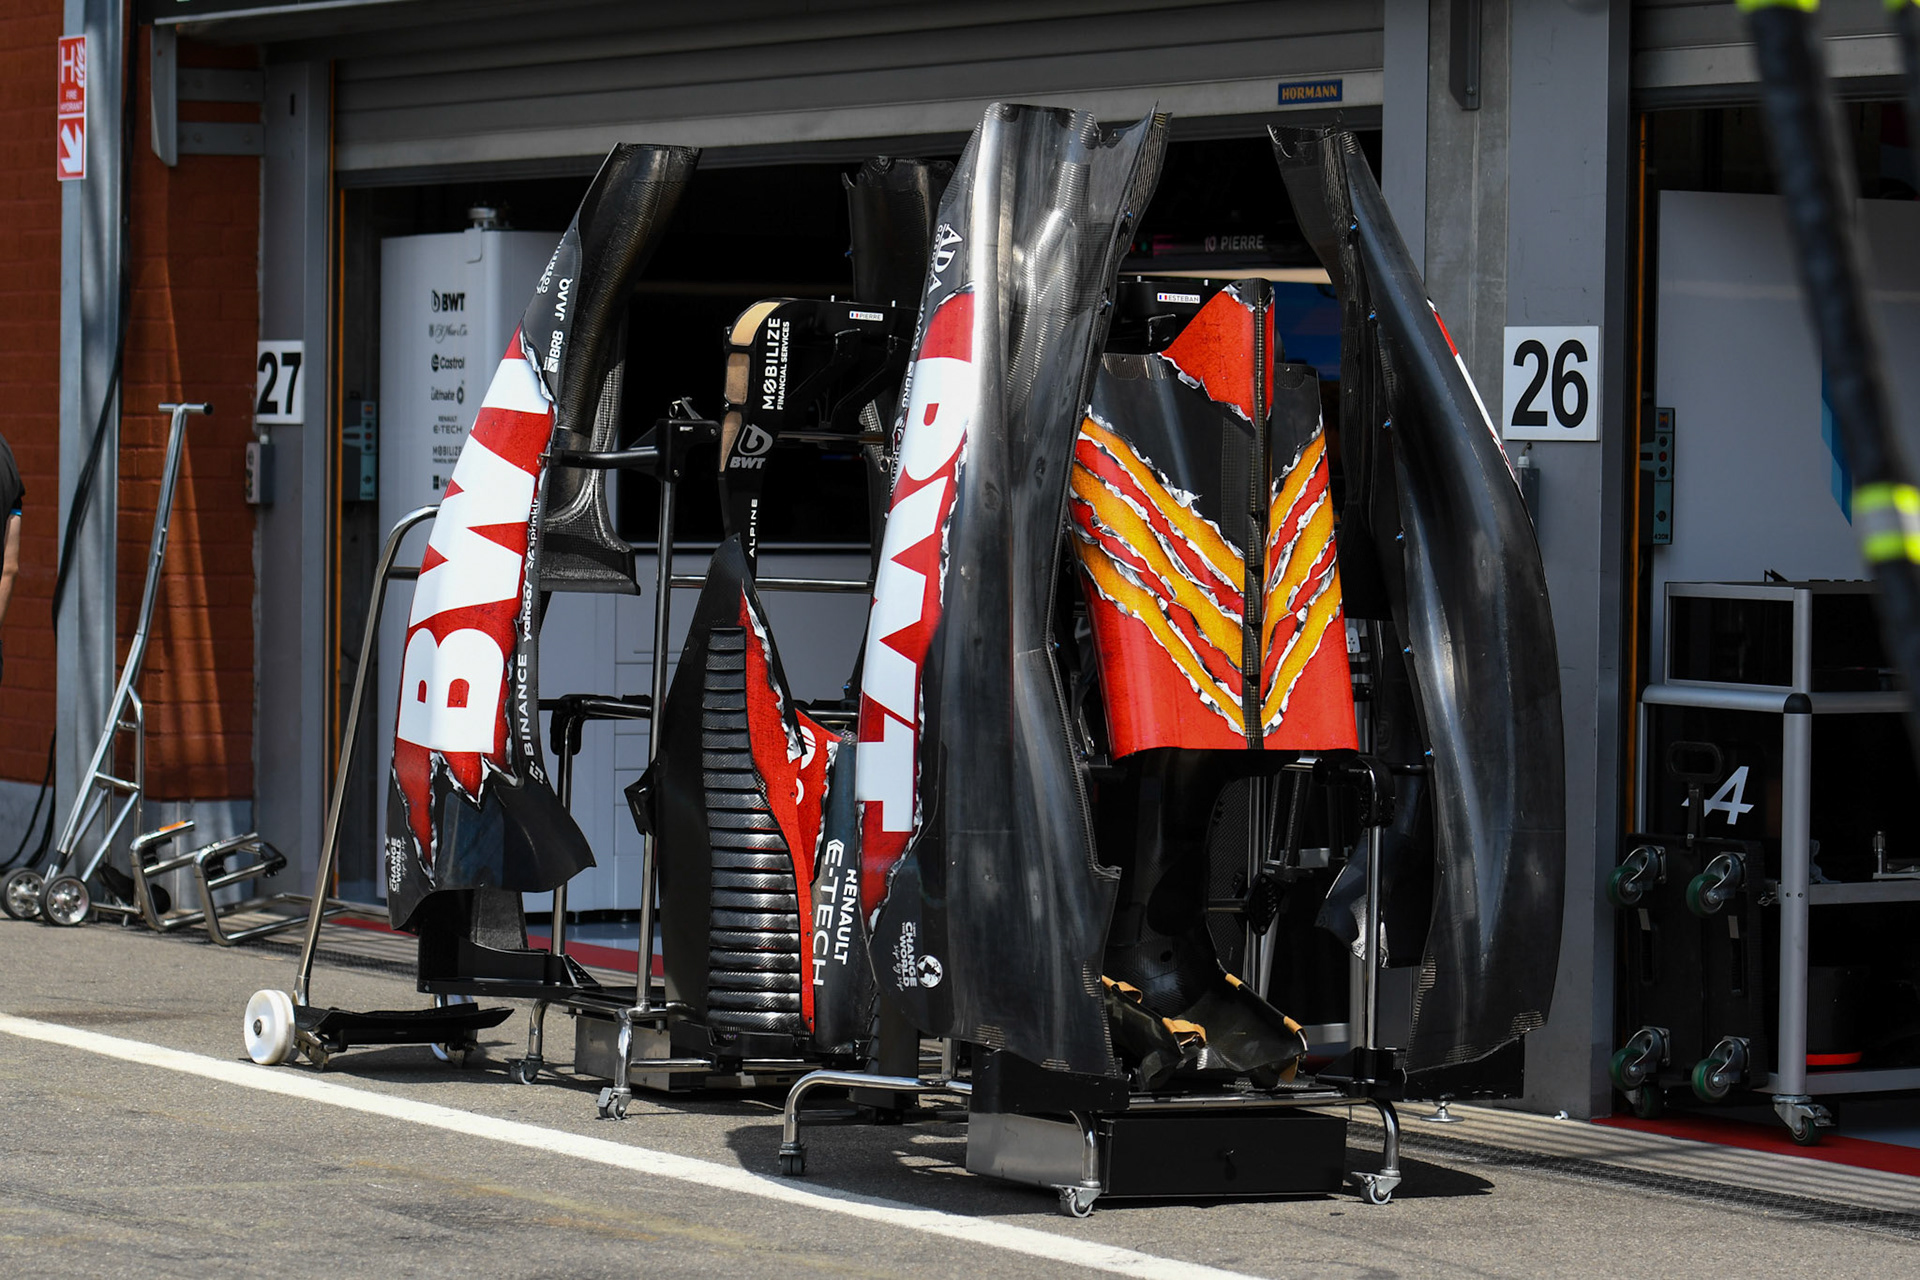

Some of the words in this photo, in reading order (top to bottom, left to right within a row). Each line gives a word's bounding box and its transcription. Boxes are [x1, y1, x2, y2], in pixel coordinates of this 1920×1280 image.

[66, 88, 77, 100] FIRE
[1221, 235, 1264, 251] PIERRE
[442, 293, 465, 311] BWT
[440, 356, 464, 369] Castrol
[550, 330, 564, 358] BRB
[780, 321, 790, 363] SERVICES
[257, 352, 301, 414] 27
[777, 364, 787, 410] FINANCIAL
[1511, 339, 1588, 428] 26
[730, 456, 766, 469] BWT
[749, 499, 758, 558] ALPINE
[523, 580, 532, 641] yahoo!
[518, 654, 534, 756] BINANCE
[812, 839, 845, 986] E-TECH
[833, 868, 857, 965] RENAULT
[900, 935, 910, 987] WORLD
[906, 921, 918, 987] CHANGE
